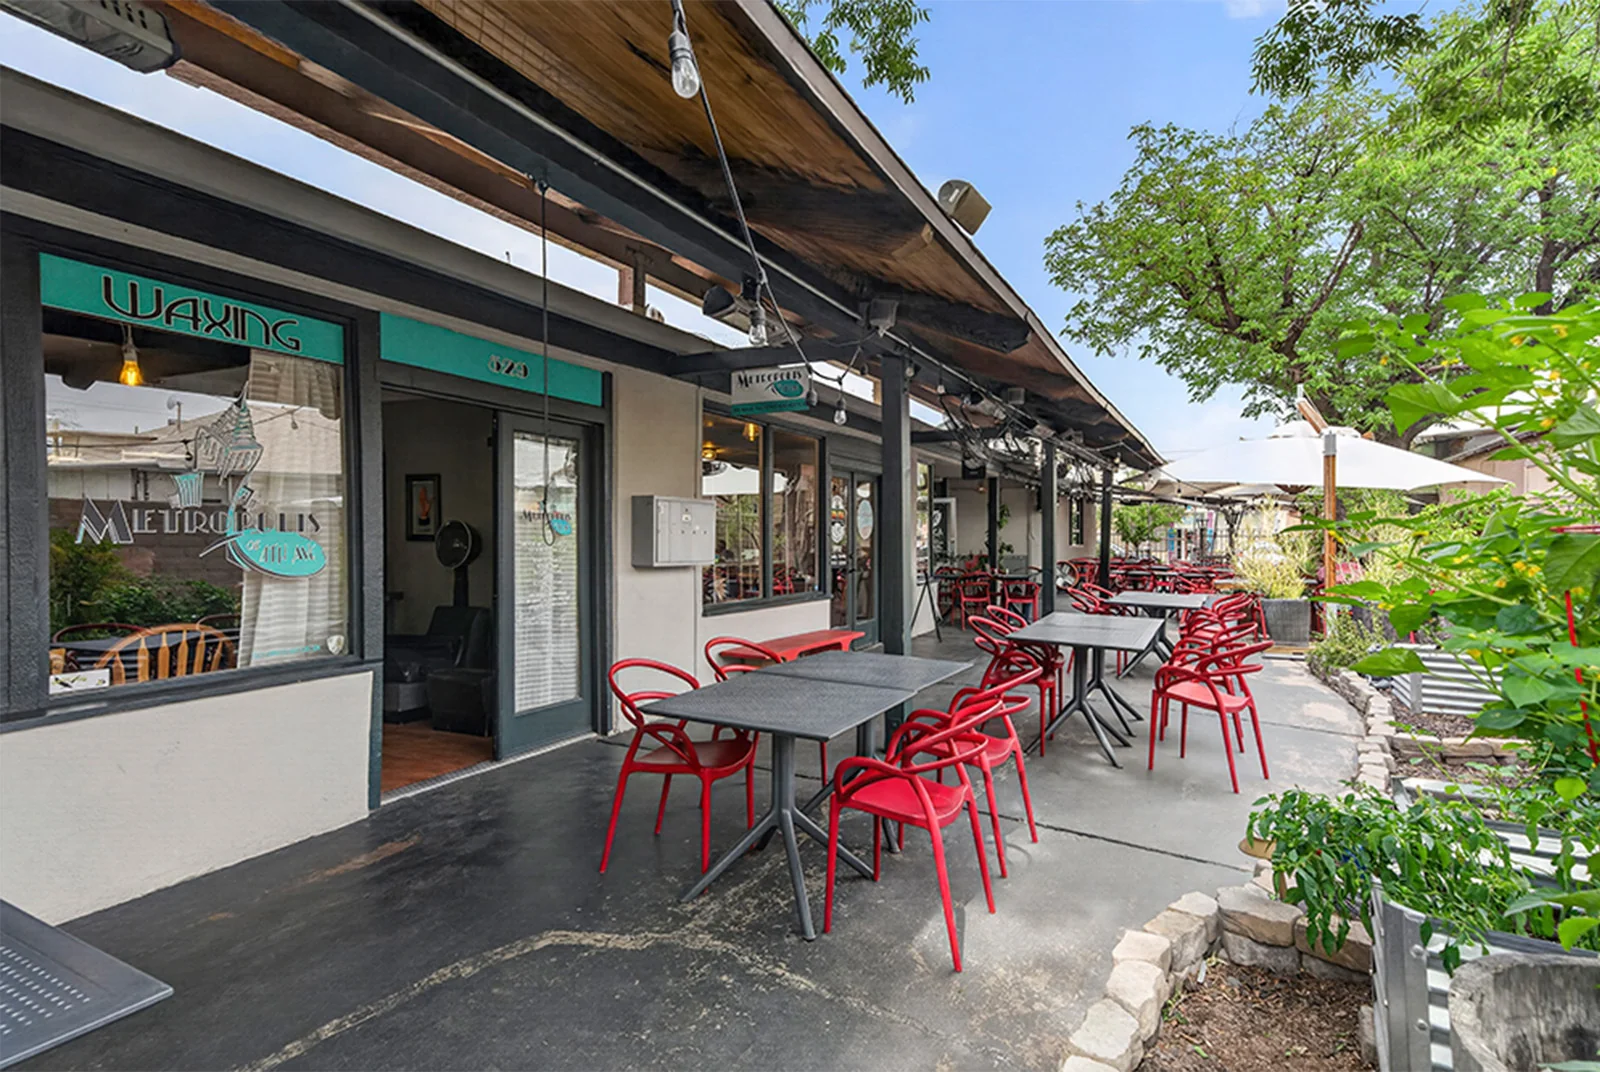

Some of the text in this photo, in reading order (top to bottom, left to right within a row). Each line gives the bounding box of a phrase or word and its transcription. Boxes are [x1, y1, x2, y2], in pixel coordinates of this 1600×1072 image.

[103, 275, 302, 351] WAXING
[737, 370, 802, 388] METROPOLIS
[74, 497, 321, 544] METROPOLIS
